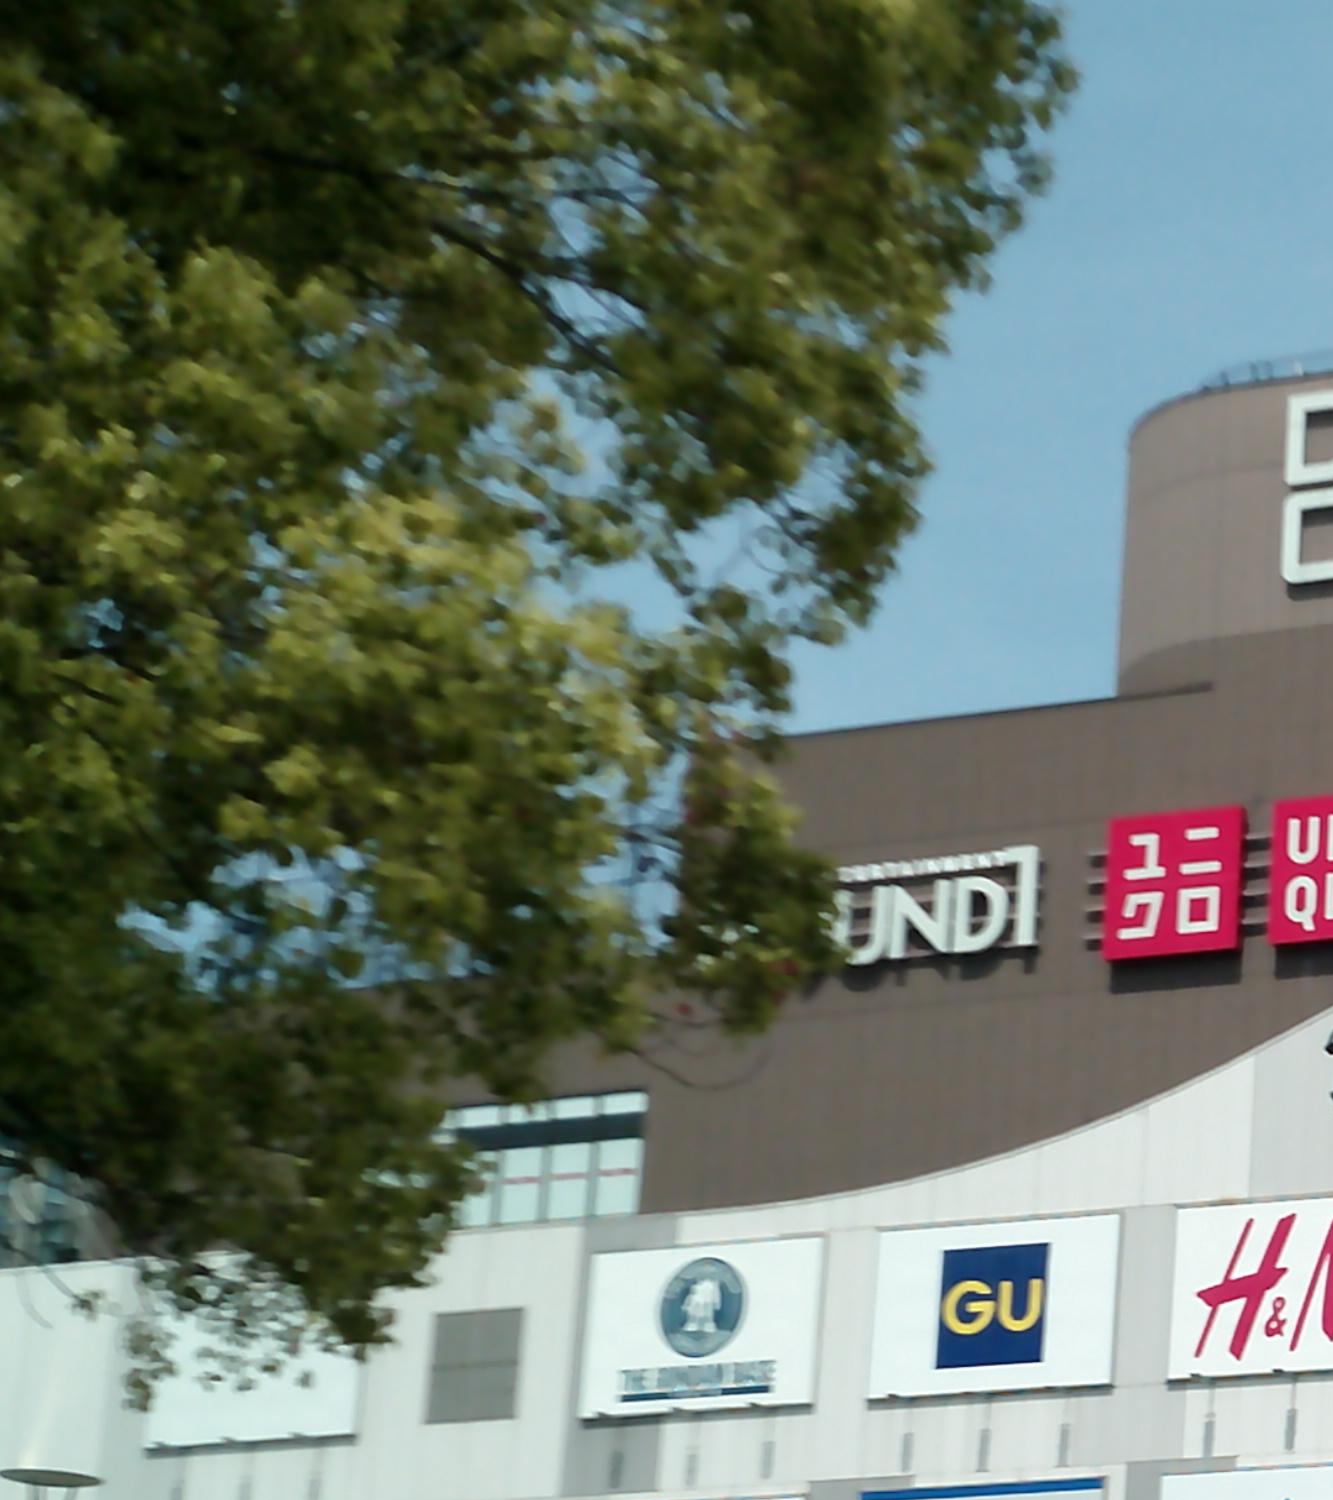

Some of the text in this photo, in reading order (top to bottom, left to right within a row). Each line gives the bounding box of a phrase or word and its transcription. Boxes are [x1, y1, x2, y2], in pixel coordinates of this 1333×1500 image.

[1123, 827, 1222, 880] ユニ
[832, 845, 1039, 966] UND1
[1115, 885, 1221, 940] クロ
[943, 1278, 1042, 1335] GU
